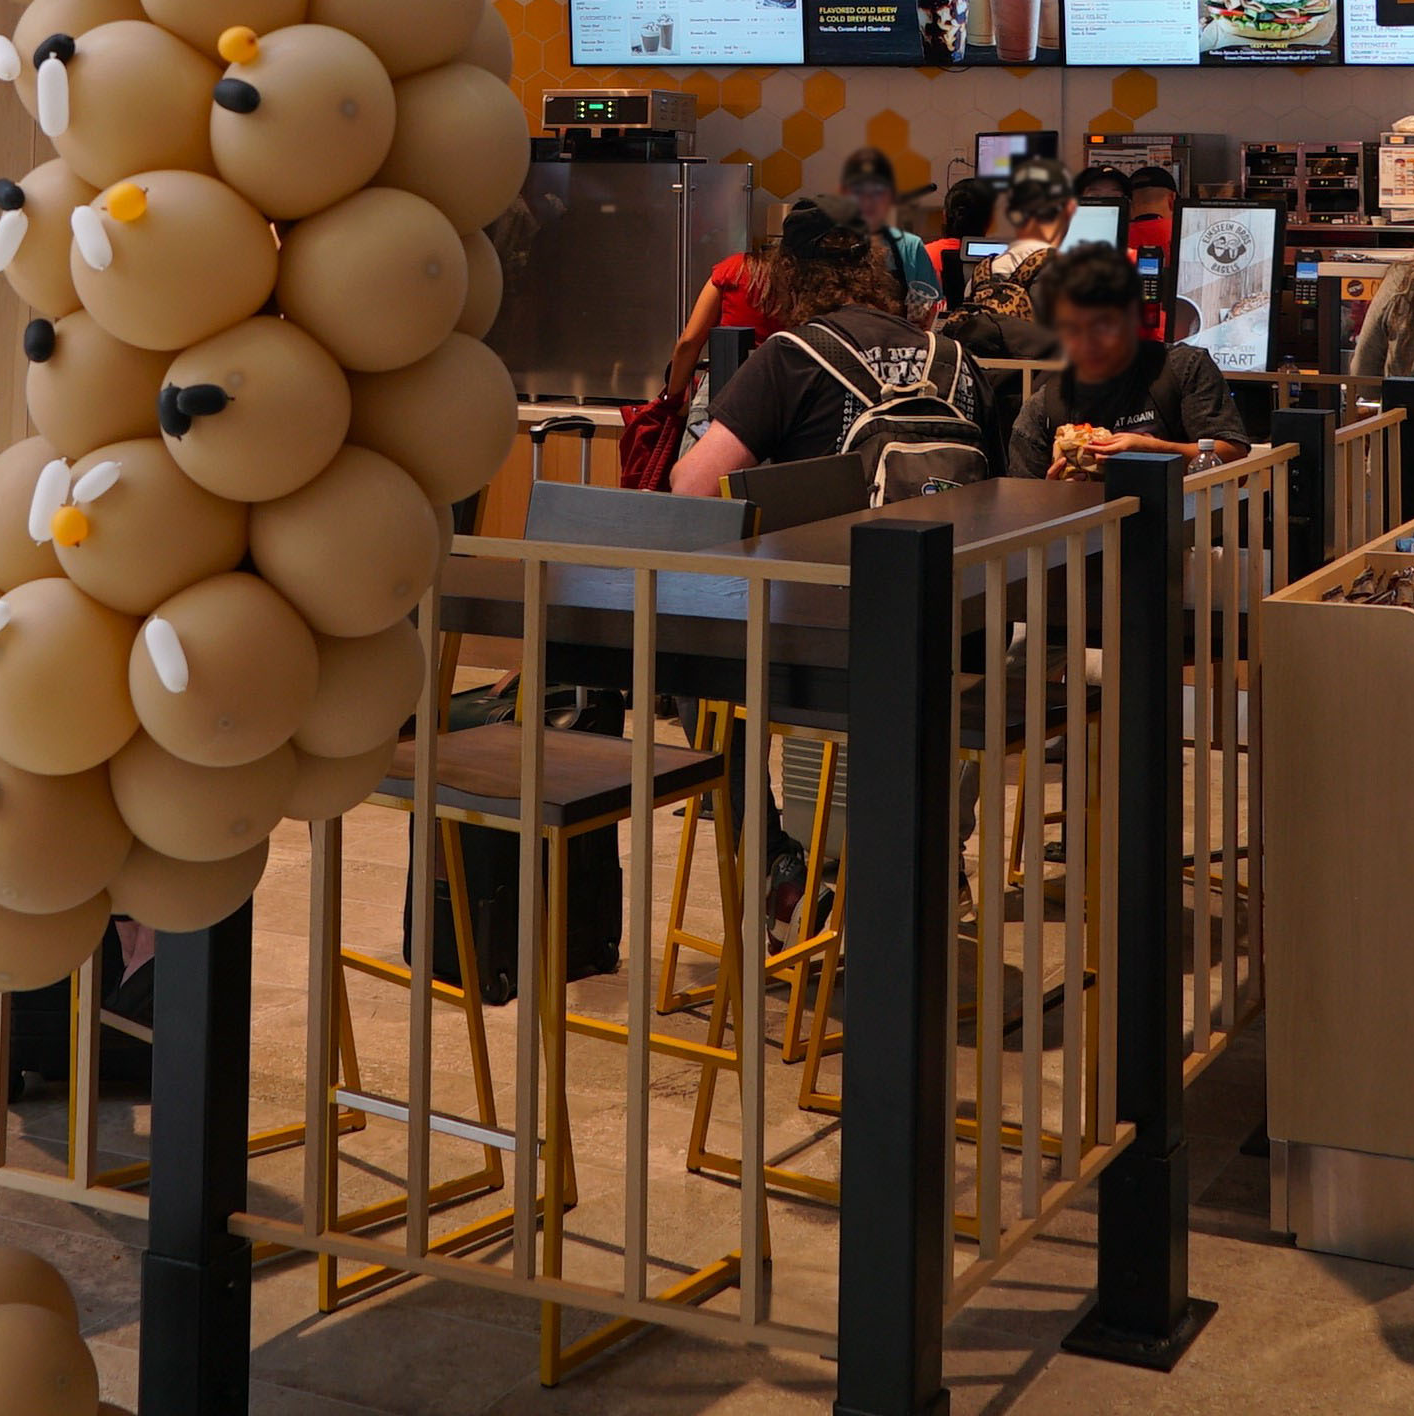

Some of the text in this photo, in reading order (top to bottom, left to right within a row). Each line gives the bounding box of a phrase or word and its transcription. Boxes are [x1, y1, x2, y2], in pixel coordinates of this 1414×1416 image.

[819, 6, 897, 14] FLAVORED COLD BREW
[819, 15, 896, 23] & COLD BREW SHAKES
[1202, 224, 1251, 244] EINSTEIN BROS
[1211, 263, 1240, 274] BAGELS
[1213, 352, 1256, 365] START
[1127, 410, 1154, 424] AGAIN
